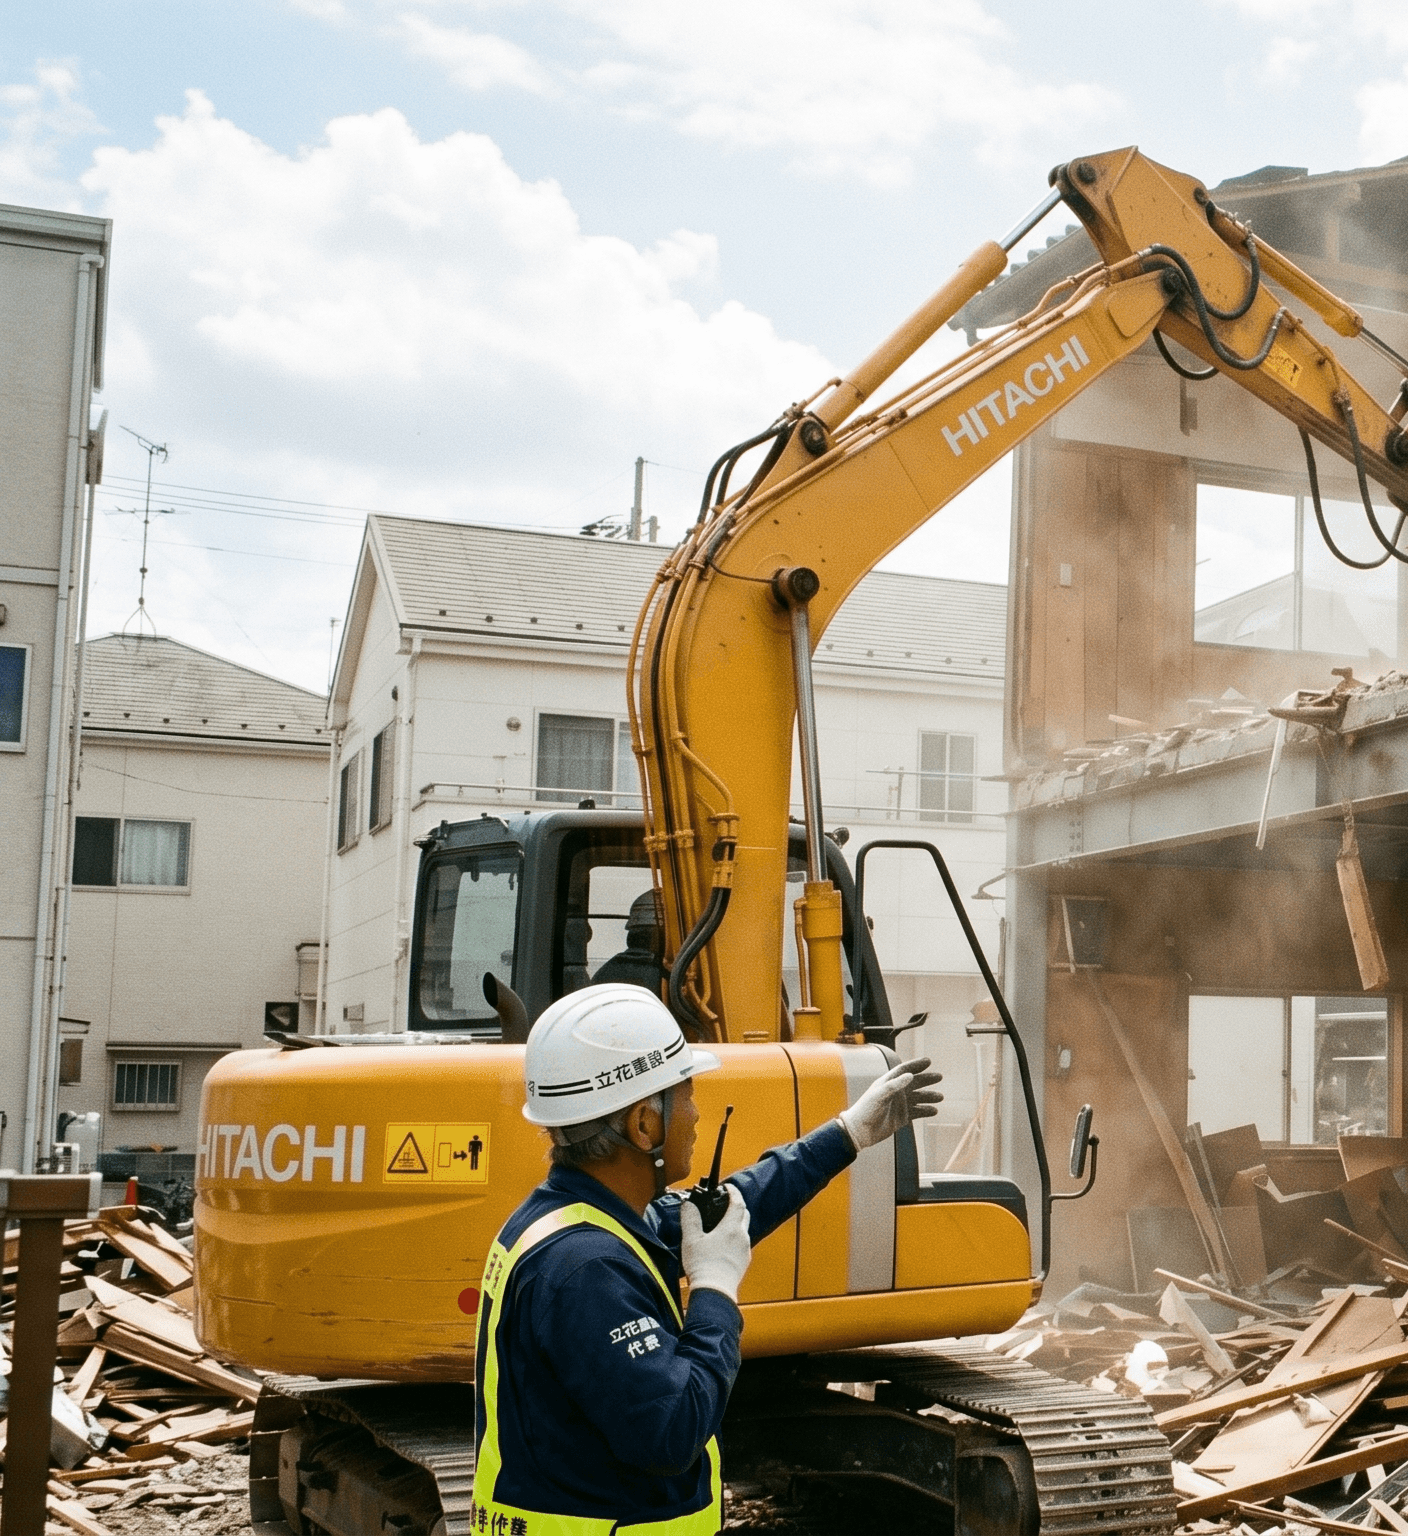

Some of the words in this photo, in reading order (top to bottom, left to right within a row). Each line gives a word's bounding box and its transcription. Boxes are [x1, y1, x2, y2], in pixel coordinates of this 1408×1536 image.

[941, 335, 1090, 457] HITACHI
[595, 1049, 665, 1090] 立花重設
[197, 1123, 367, 1183] HITACHI
